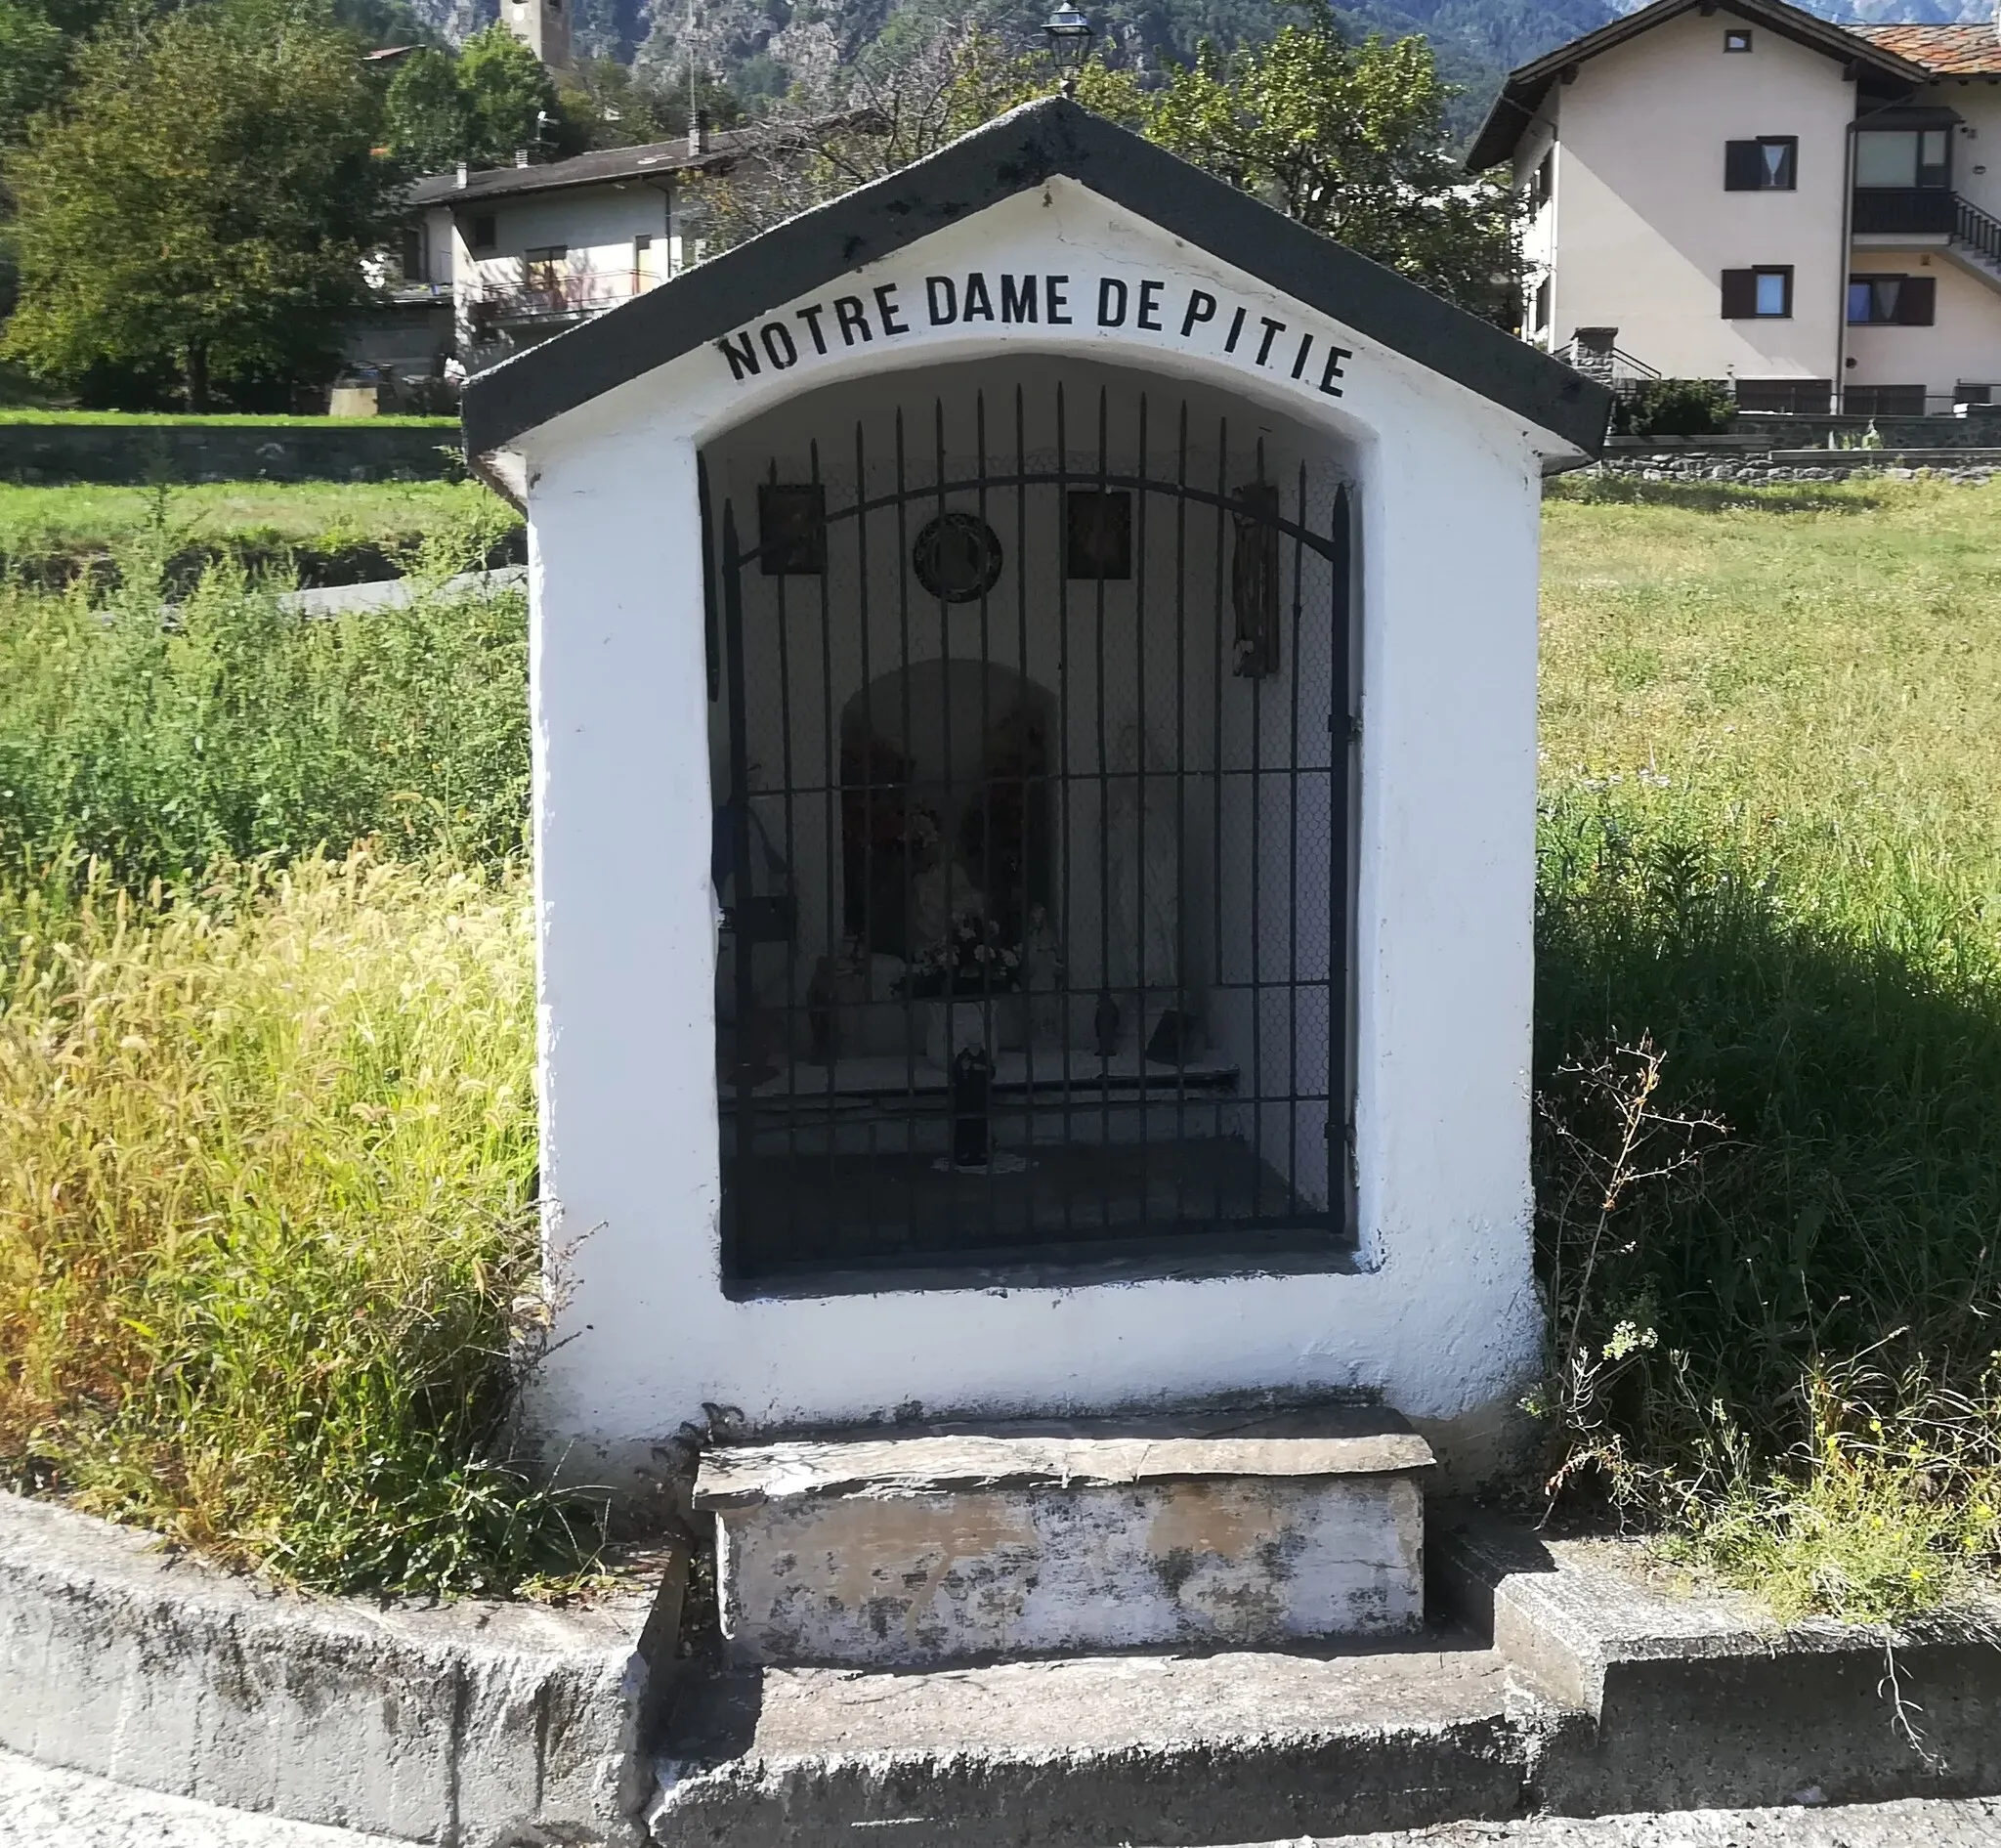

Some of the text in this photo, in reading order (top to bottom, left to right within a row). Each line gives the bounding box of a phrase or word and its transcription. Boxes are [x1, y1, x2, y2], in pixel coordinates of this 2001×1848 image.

[721, 272, 1353, 399] NOTRE DAME DE PITIE
